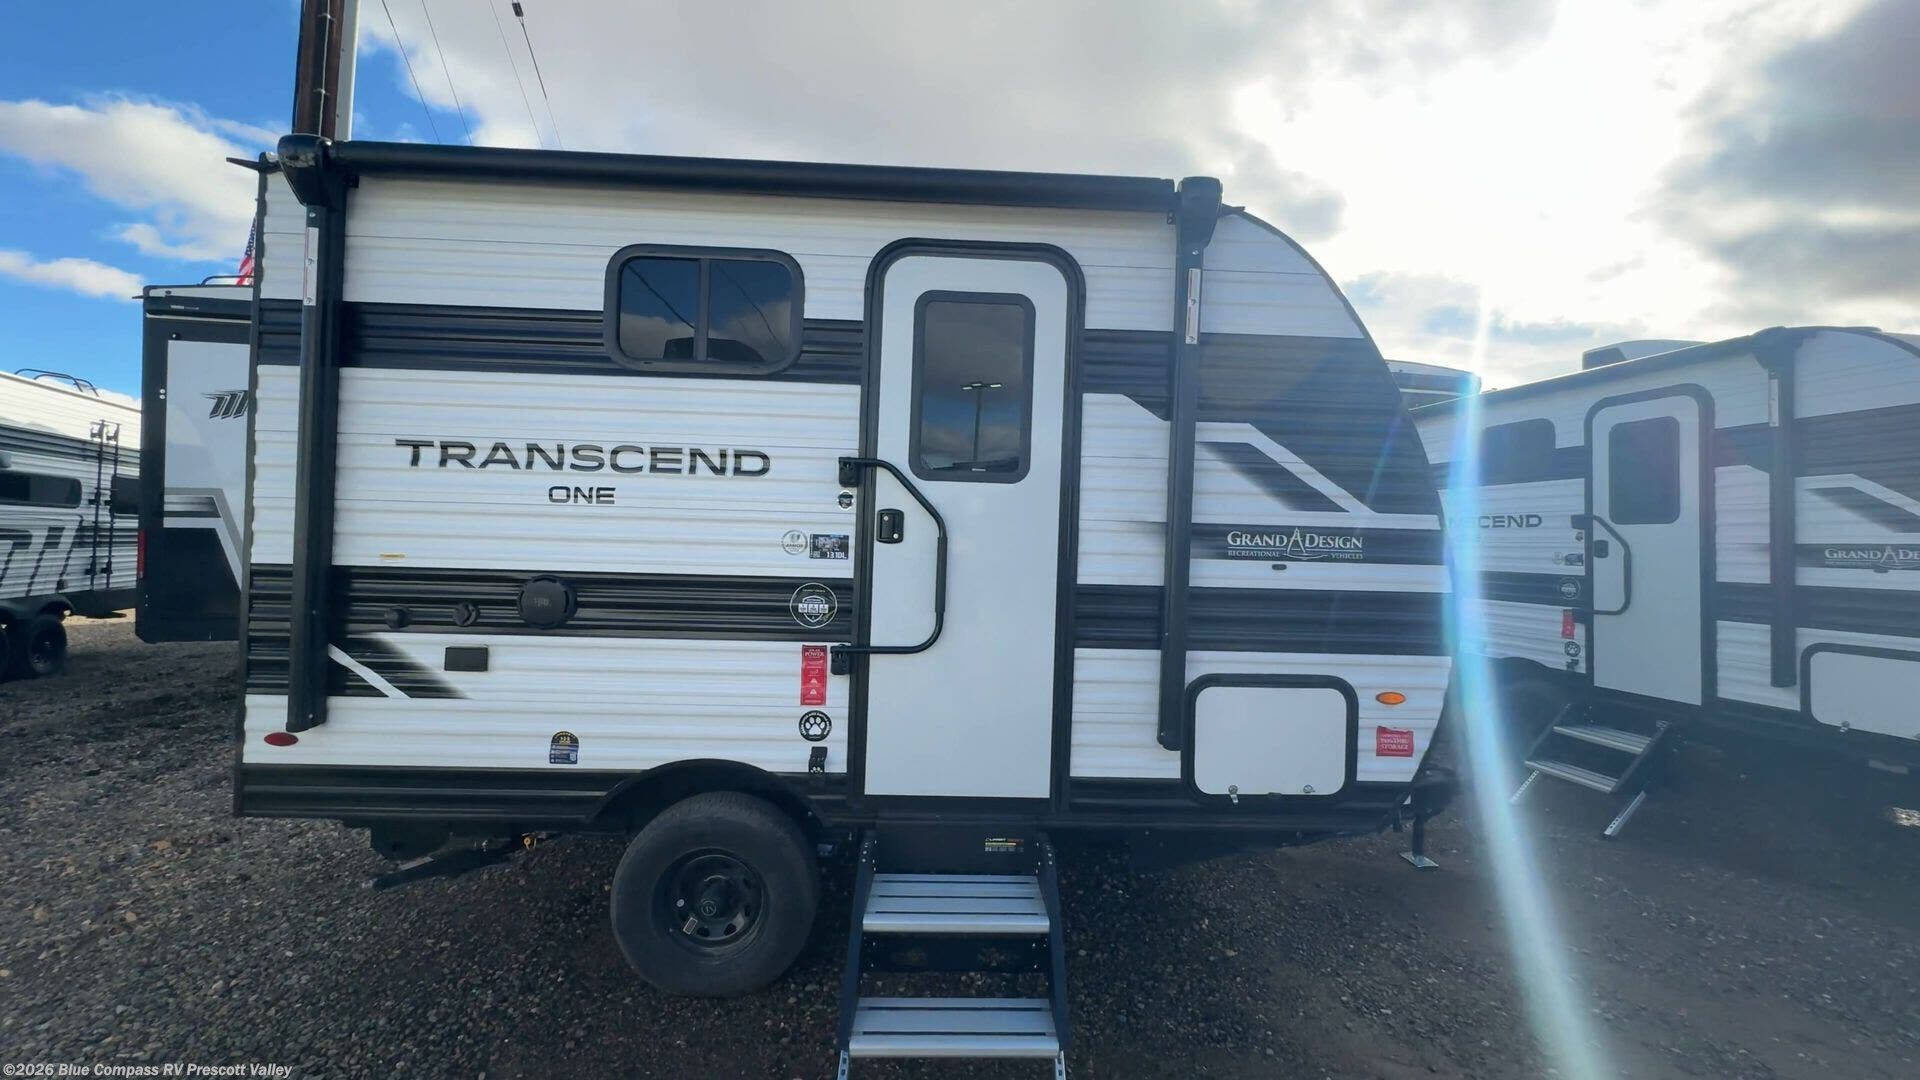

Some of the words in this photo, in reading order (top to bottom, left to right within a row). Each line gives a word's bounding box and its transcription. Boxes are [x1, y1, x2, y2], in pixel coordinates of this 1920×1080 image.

[394, 438, 771, 478] TRANSCEND
[548, 485, 617, 505] ONE
[1227, 531, 1288, 548] GRAND
[1304, 532, 1364, 549] DESIGN
[1227, 550, 1280, 558] RECREATIONAL
[1330, 552, 1364, 560] VEHICLES
[1824, 548, 1881, 560] GRAND
